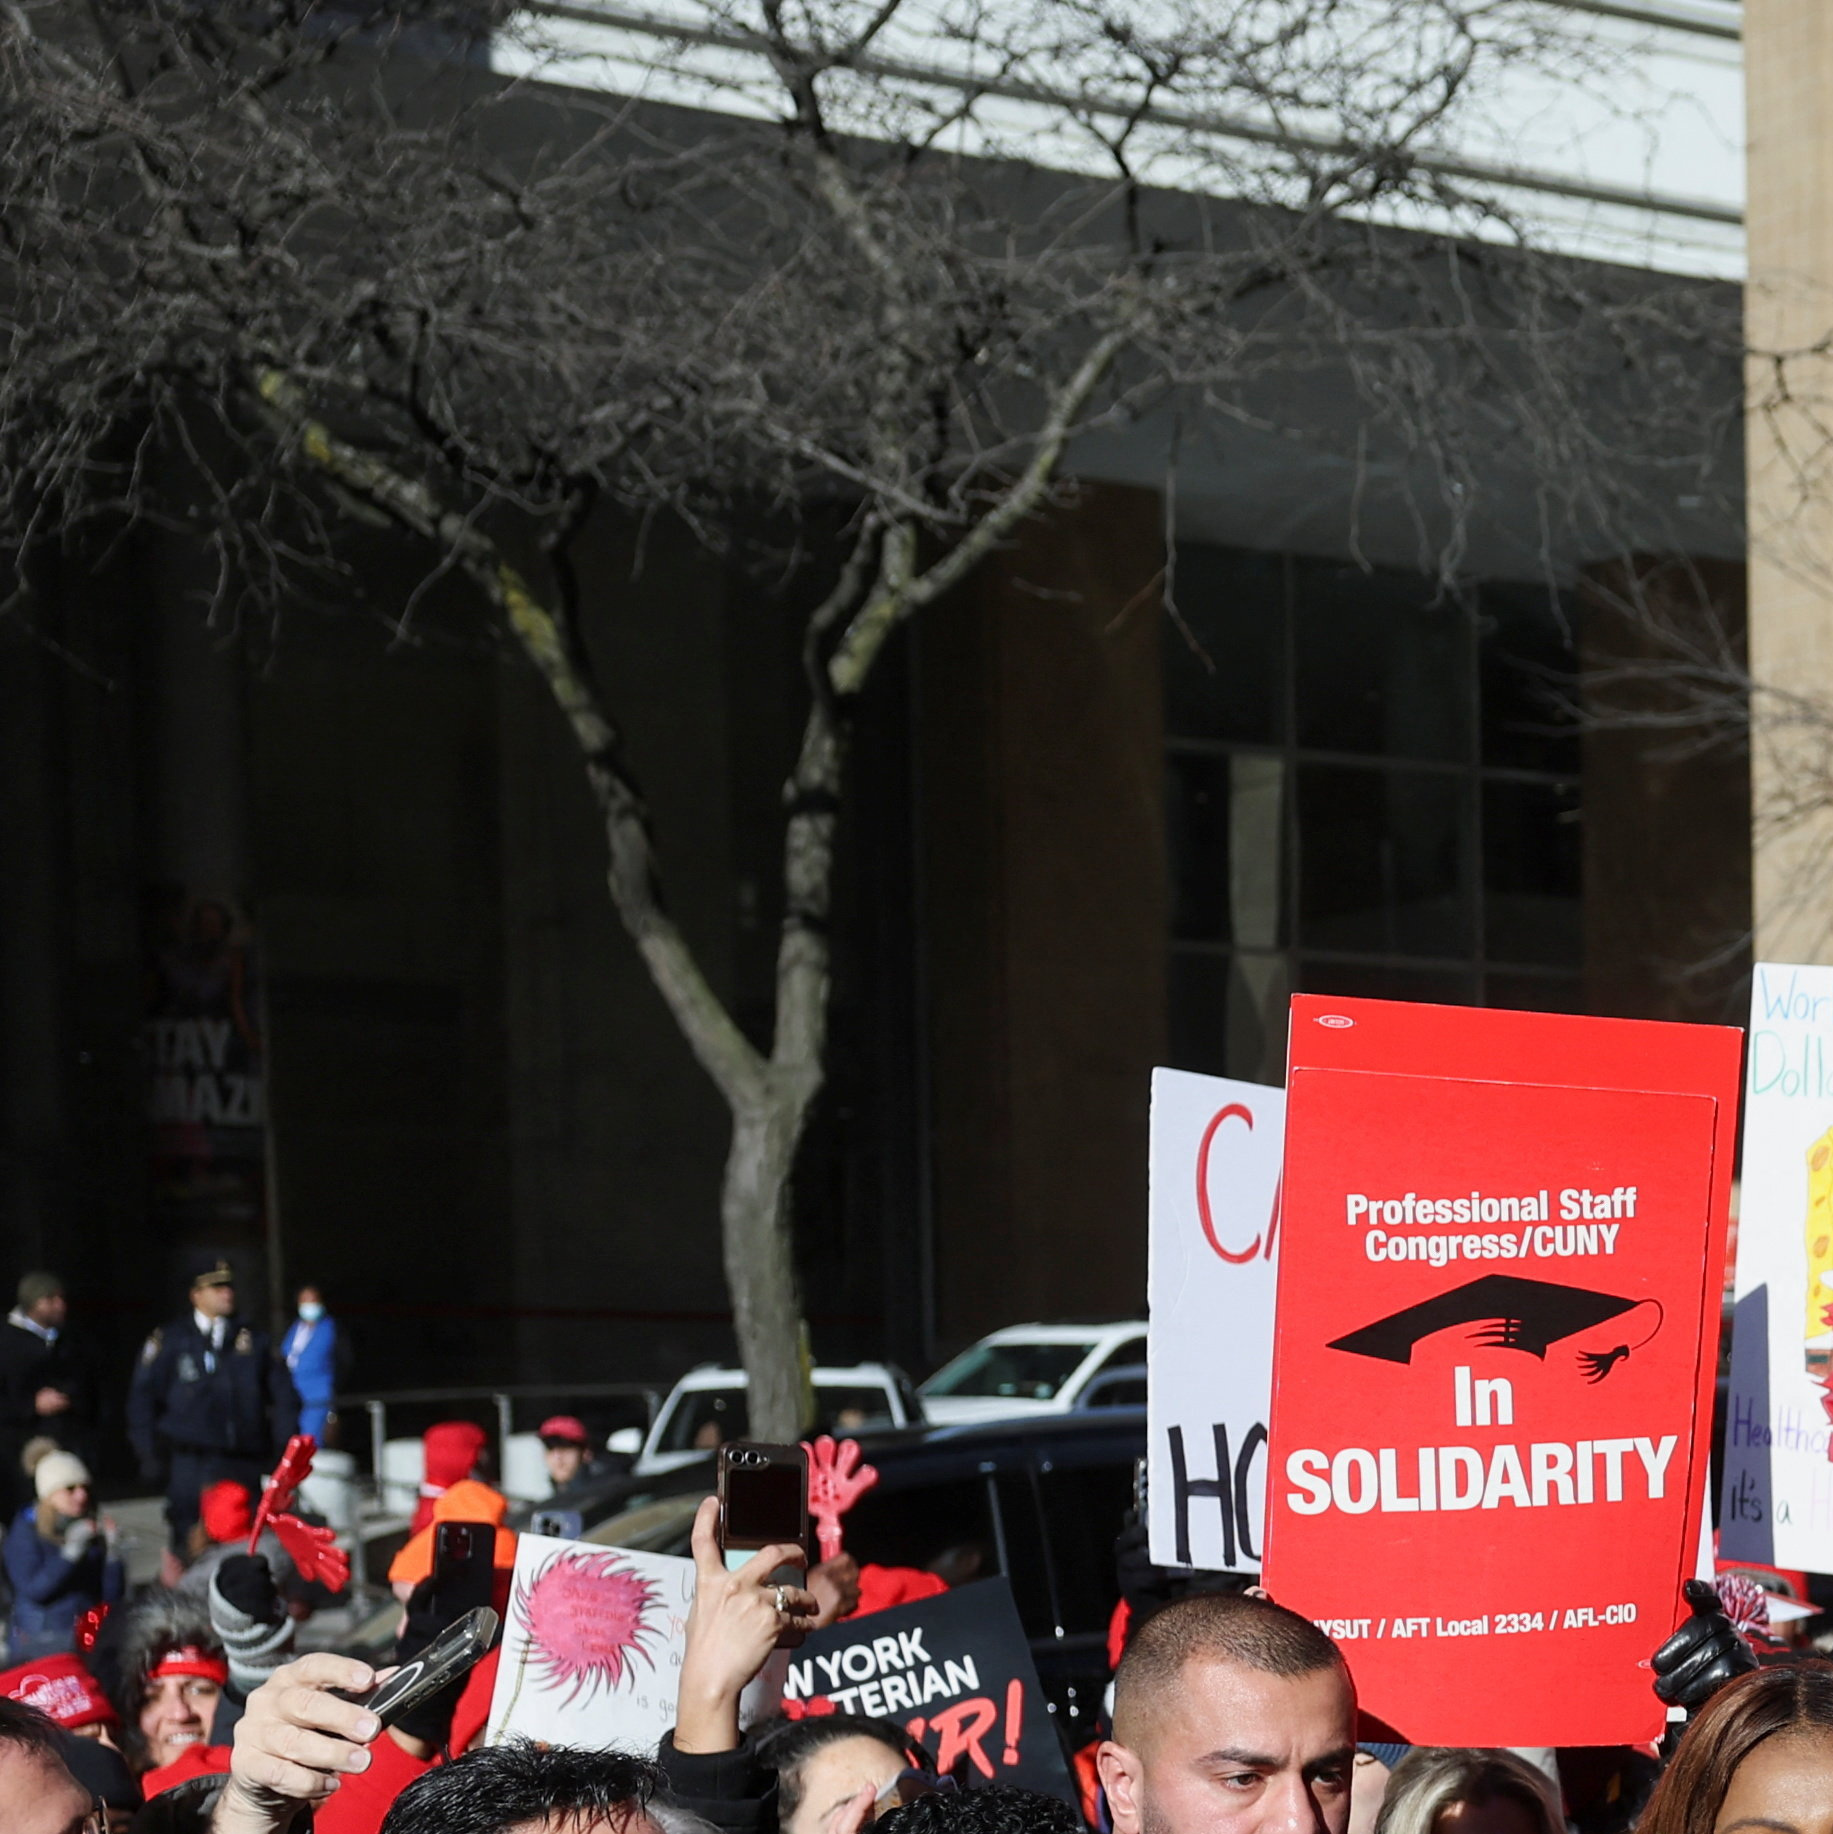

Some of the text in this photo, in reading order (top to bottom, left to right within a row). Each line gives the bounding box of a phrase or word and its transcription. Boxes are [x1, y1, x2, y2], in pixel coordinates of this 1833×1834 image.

[1345, 1186, 1637, 1226] Professional Staff
[1364, 1223, 1620, 1268] Congress/CUNY
[1453, 1365, 1515, 1427] In
[1285, 1434, 1678, 1515] SOLIDARITY
[1391, 1617, 1431, 1639] AFT
[1436, 1614, 1489, 1638] Local
[1494, 1611, 1545, 1635] 2334
[1562, 1602, 1638, 1630] AFL-CIO
[815, 1626, 933, 1689] YORK
